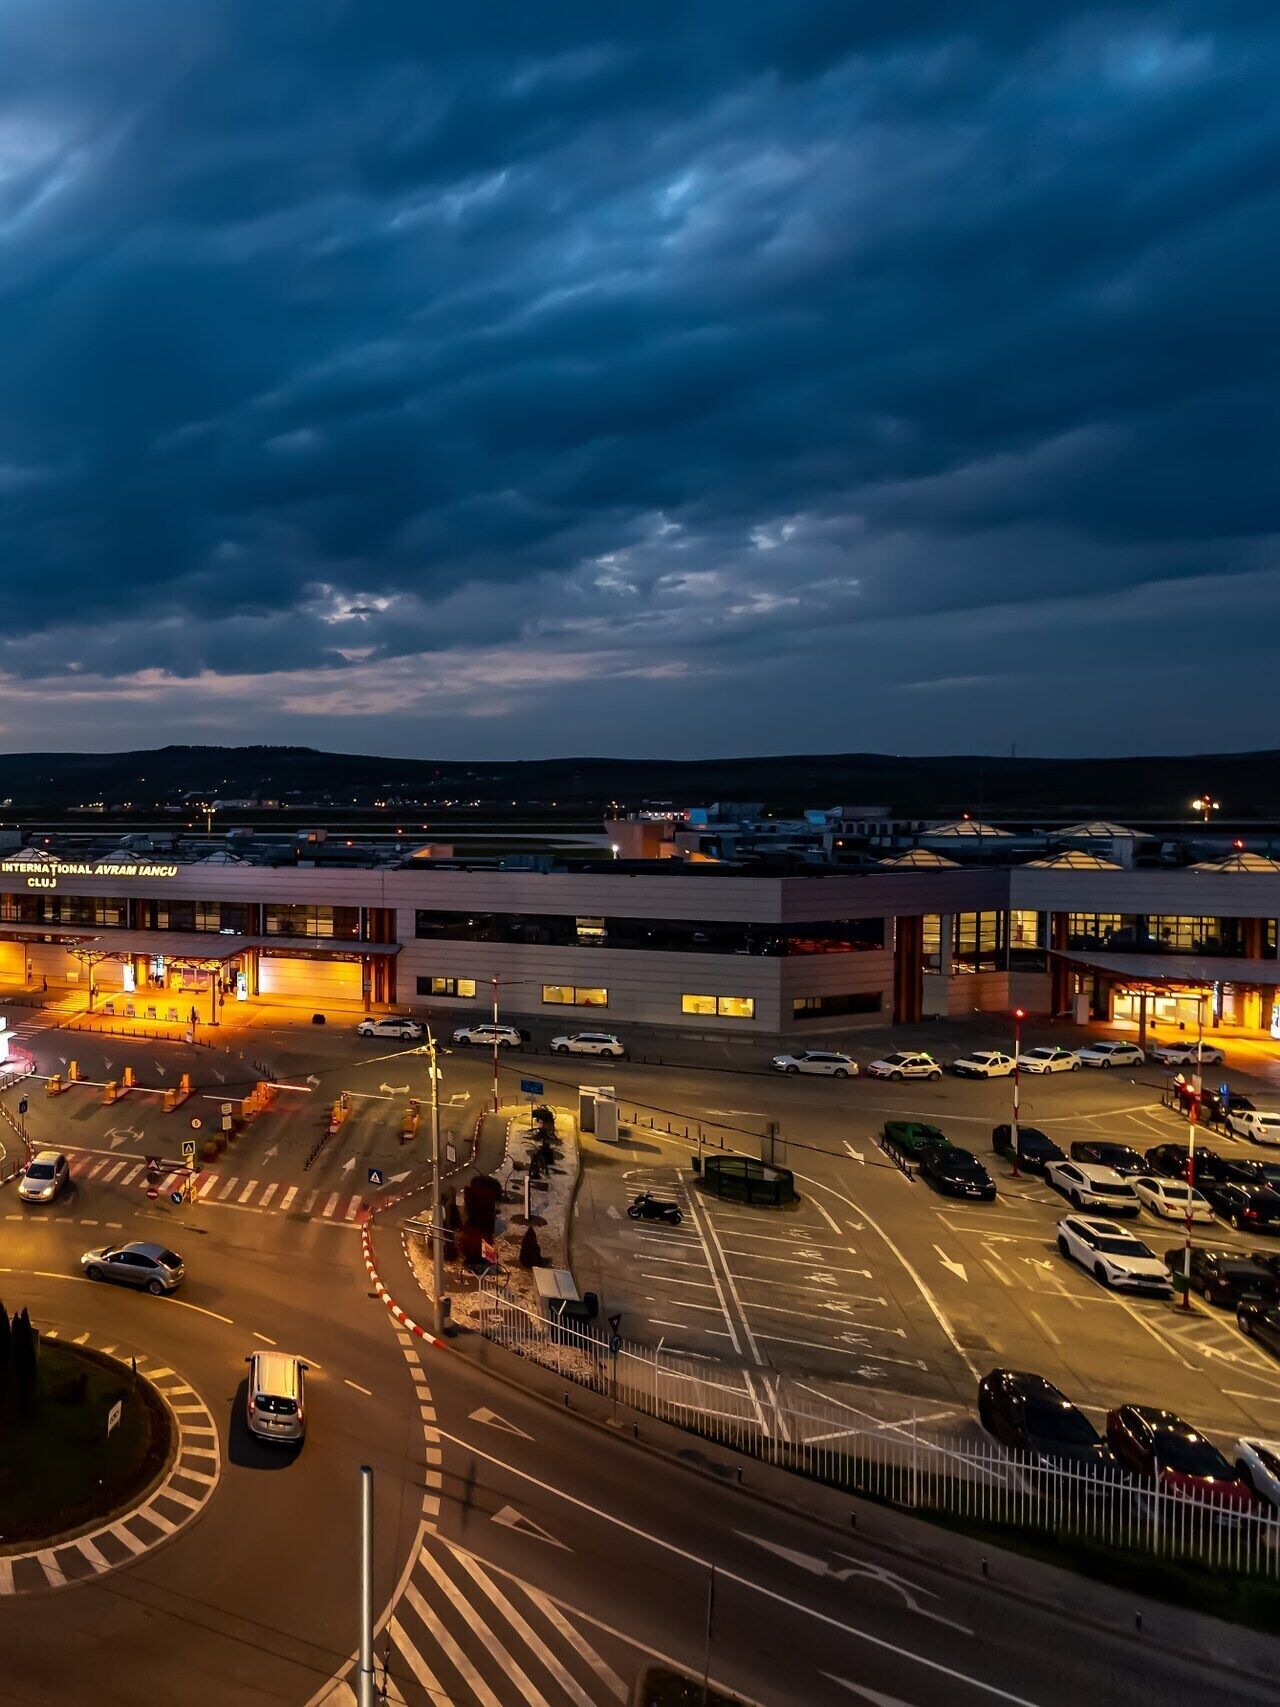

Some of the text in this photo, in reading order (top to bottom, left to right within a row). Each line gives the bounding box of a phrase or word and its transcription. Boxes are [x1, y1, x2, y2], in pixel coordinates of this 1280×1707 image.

[94, 864, 137, 876] AVRAM
[138, 865, 178, 877] IANCU
[27, 877, 57, 888] CLUJ
